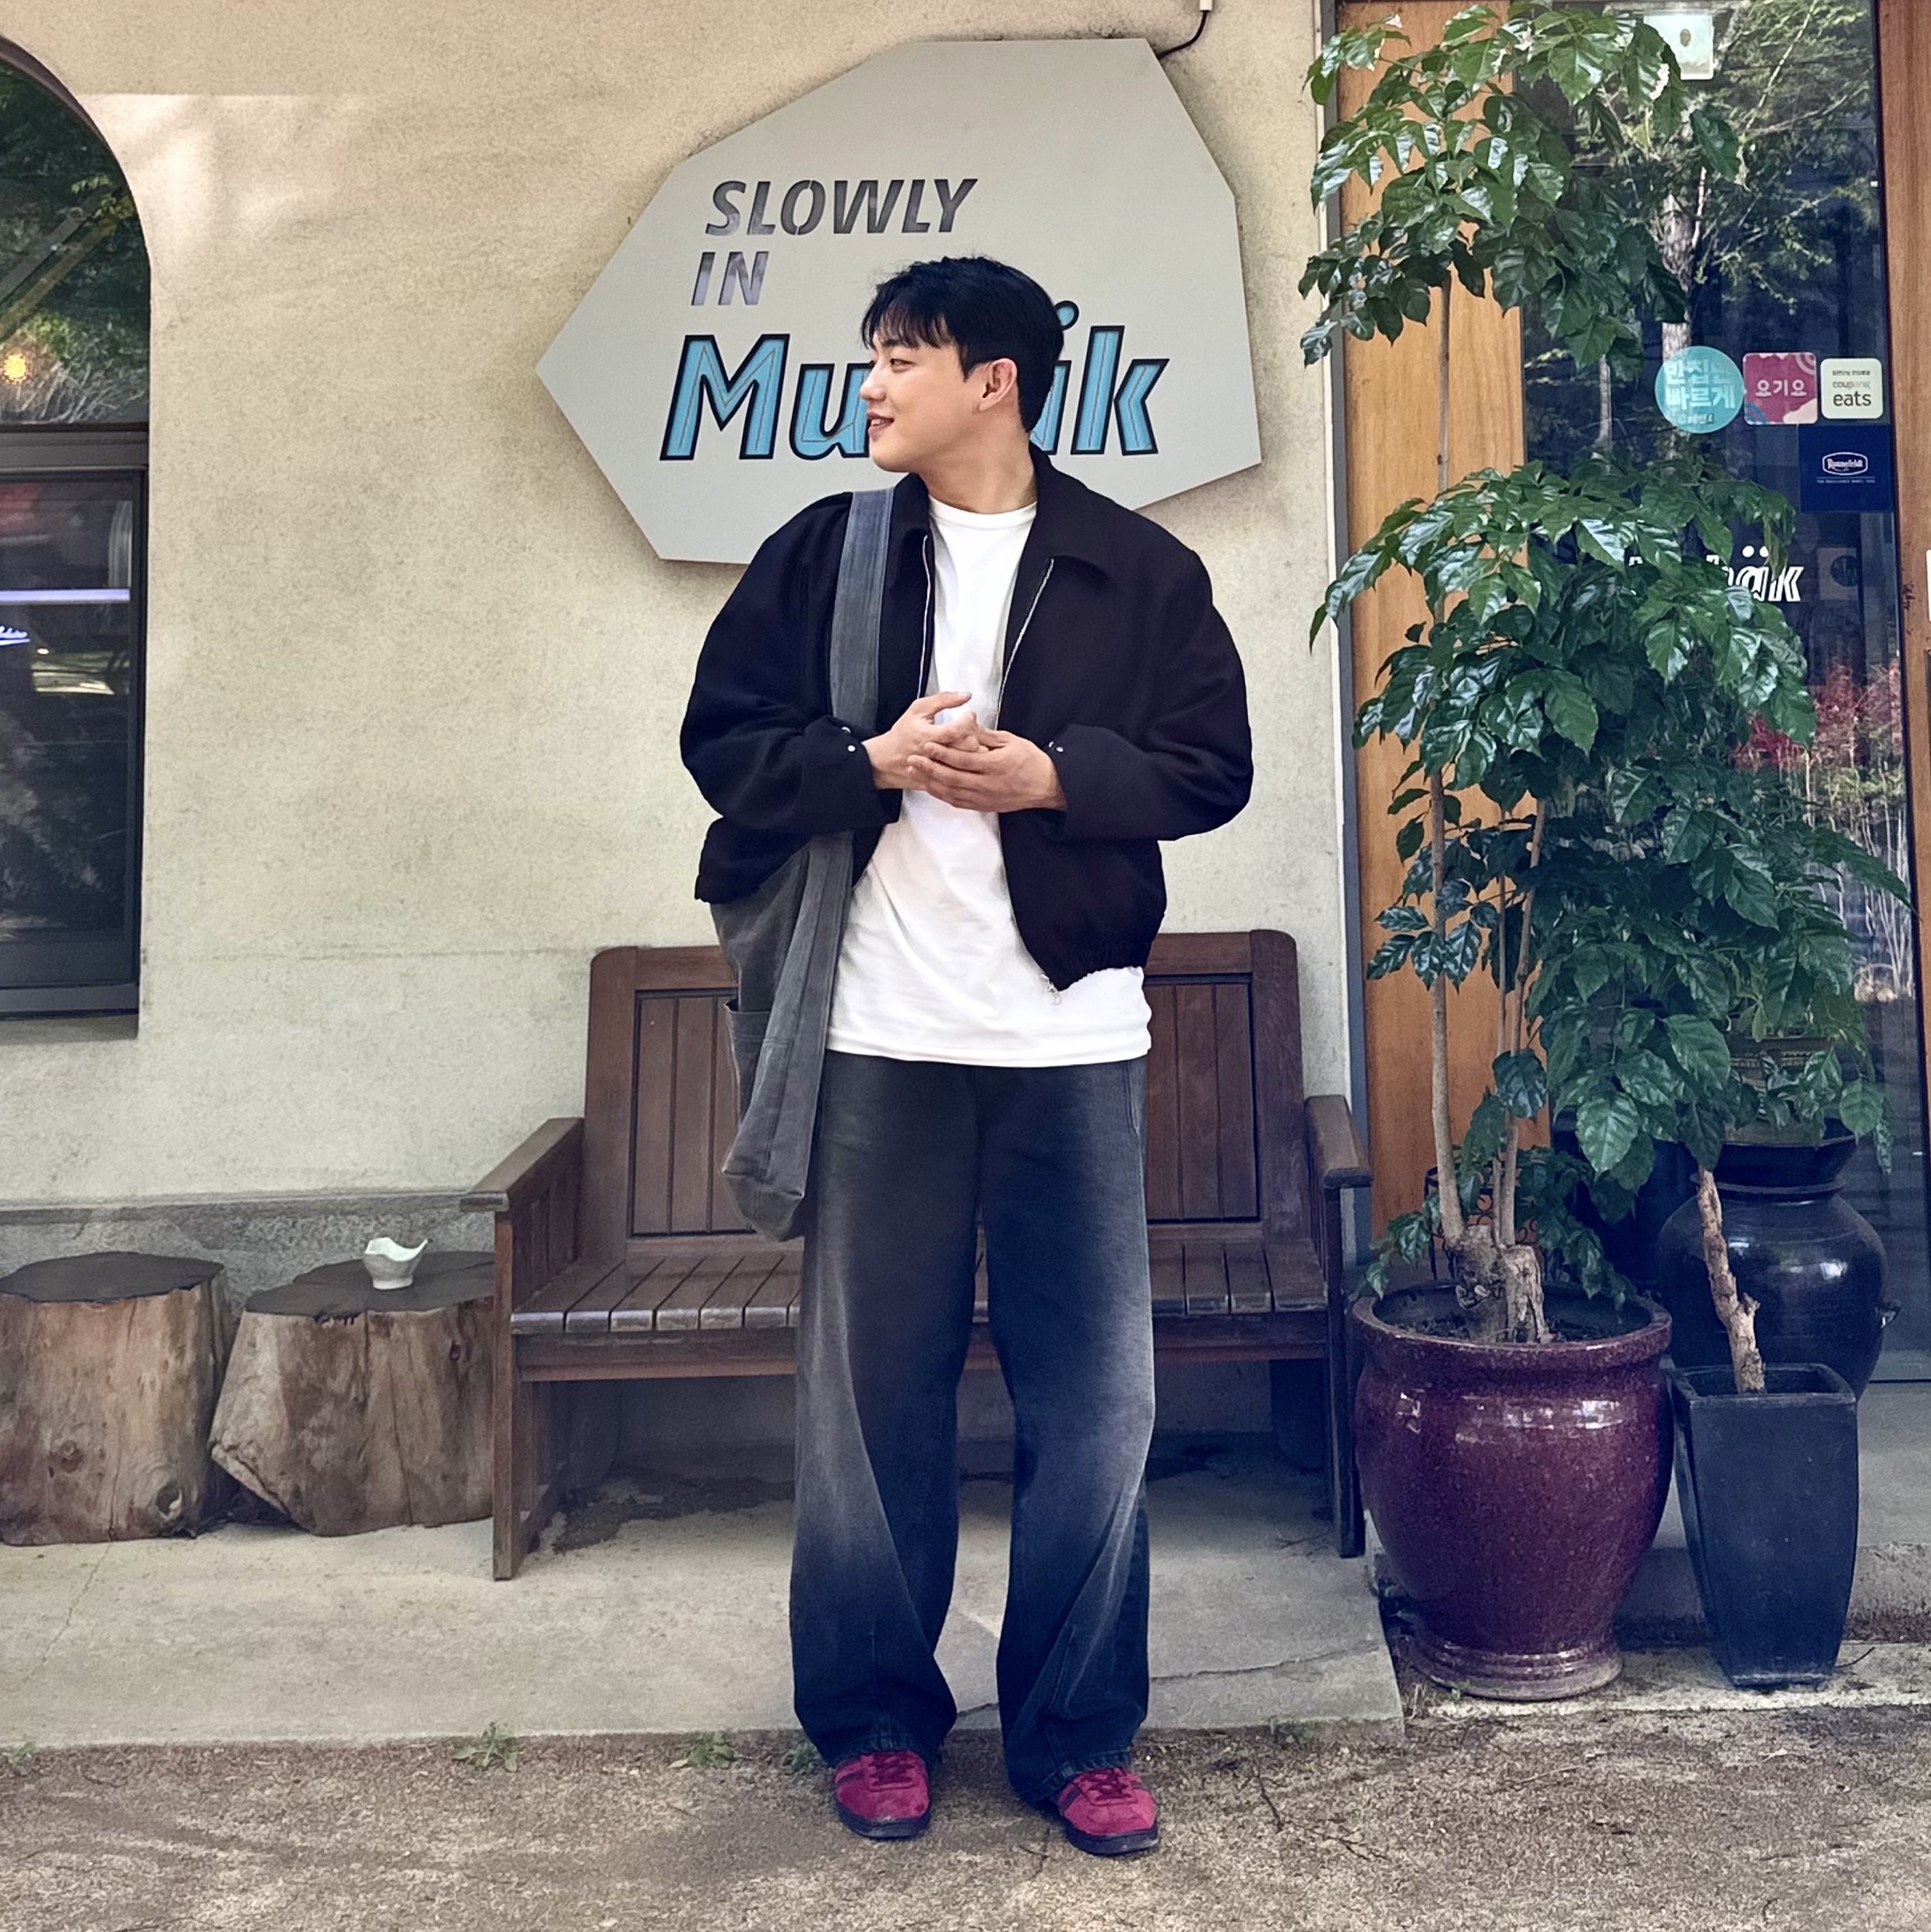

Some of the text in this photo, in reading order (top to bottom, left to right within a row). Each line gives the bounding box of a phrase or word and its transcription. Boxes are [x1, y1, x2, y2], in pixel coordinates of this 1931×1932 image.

[705, 178, 978, 236] SLOWLY
[691, 251, 769, 306] IN
[1665, 385, 1736, 410] 빠르게
[1755, 379, 1807, 397] 요기요
[1833, 390, 1872, 406] eats
